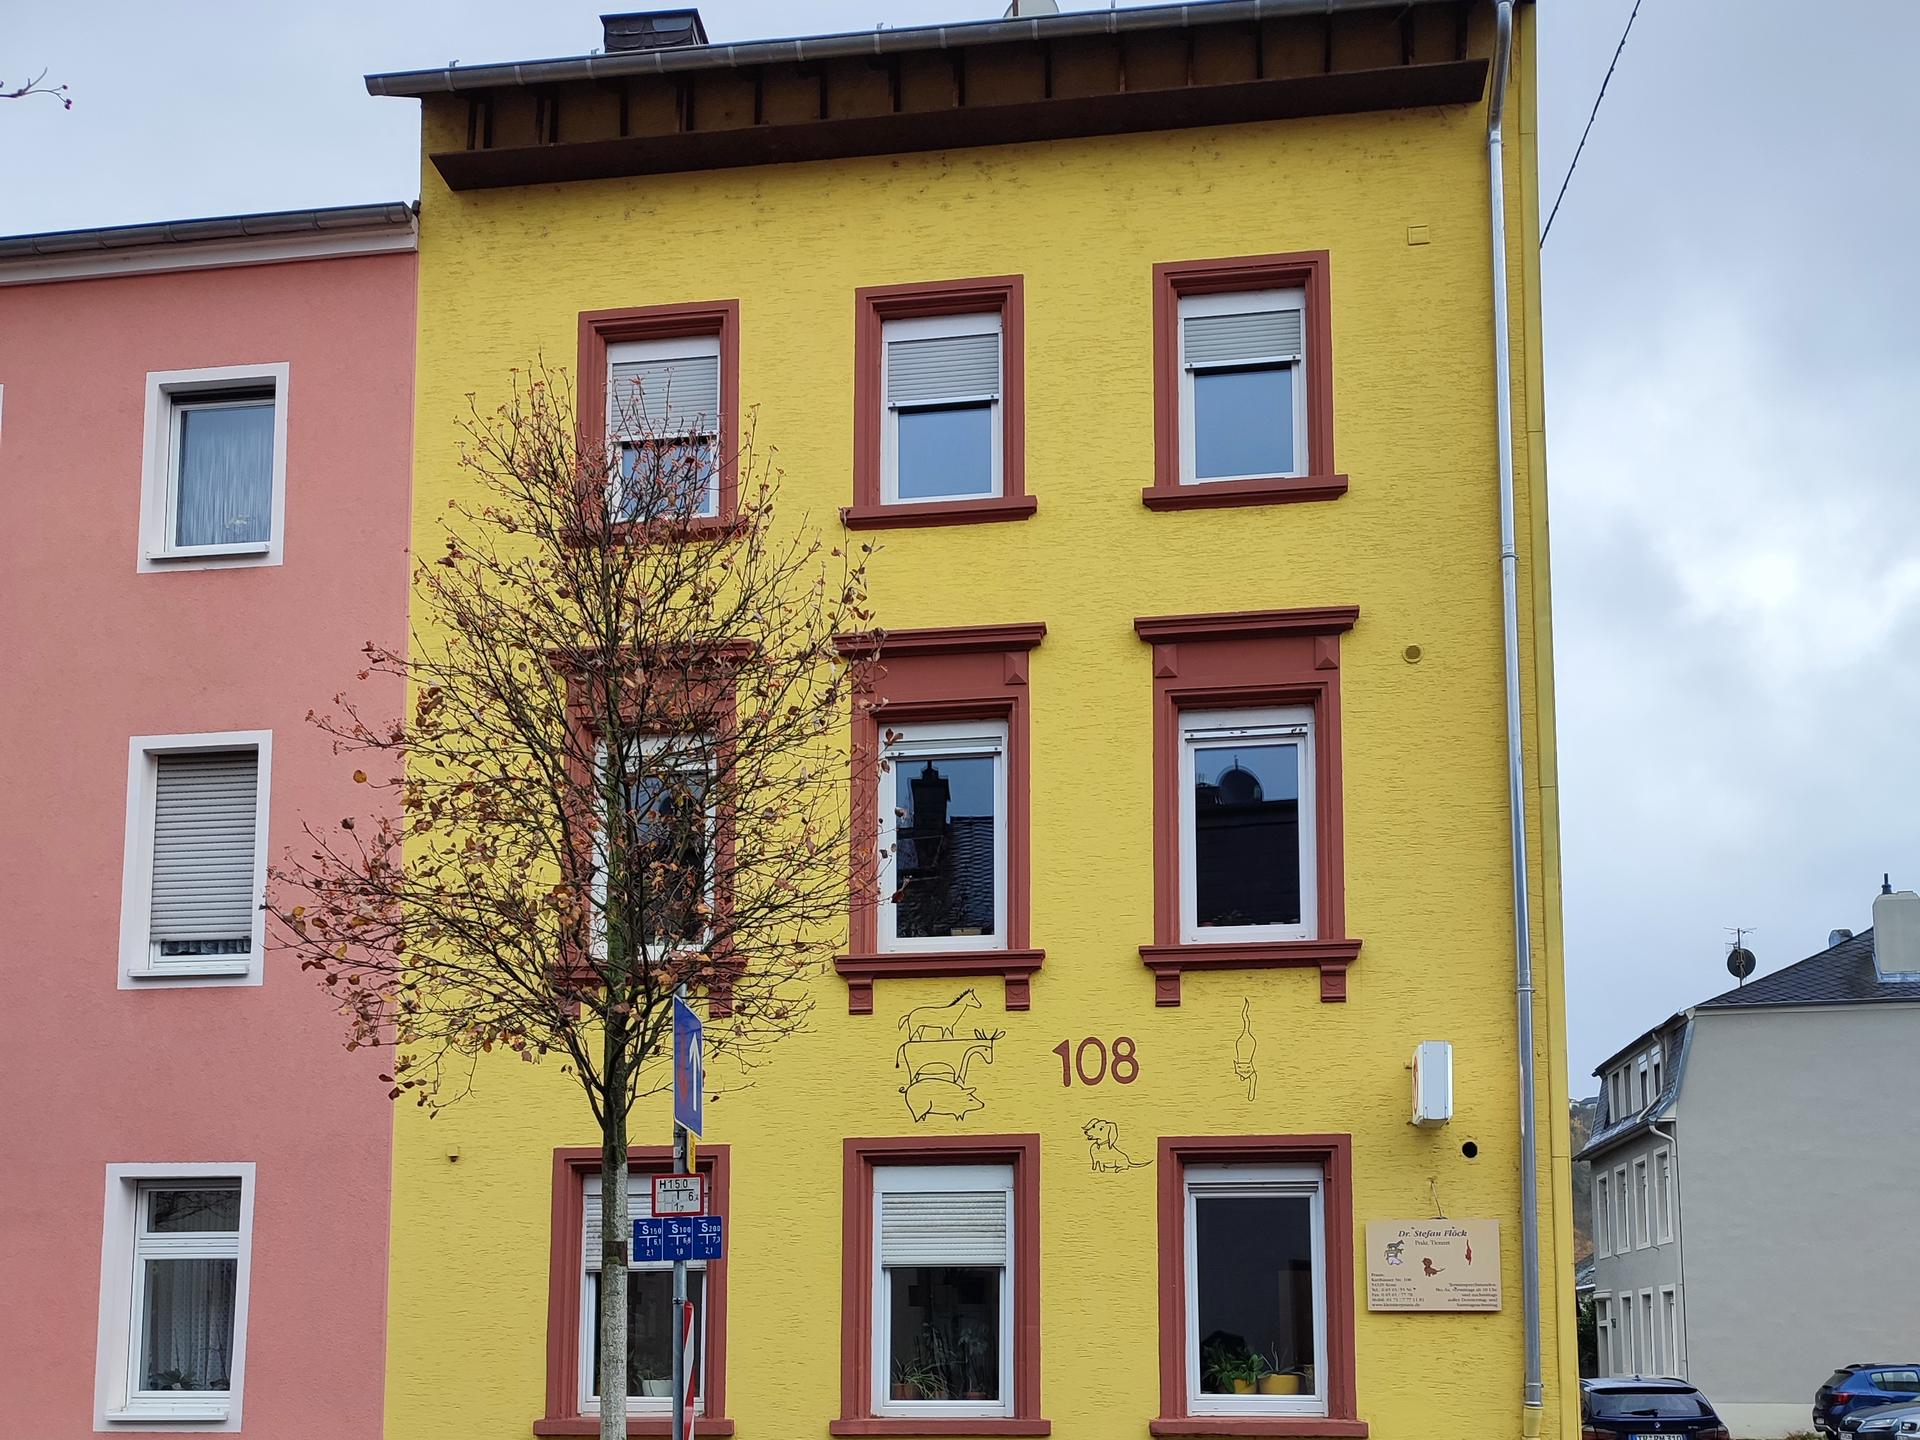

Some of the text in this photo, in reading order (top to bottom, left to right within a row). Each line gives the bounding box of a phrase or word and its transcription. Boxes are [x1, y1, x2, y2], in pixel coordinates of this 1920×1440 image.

[1052, 1036, 1139, 1088] 108
[659, 1179, 688, 1189] H150
[1414, 1230, 1441, 1239] Stefan
